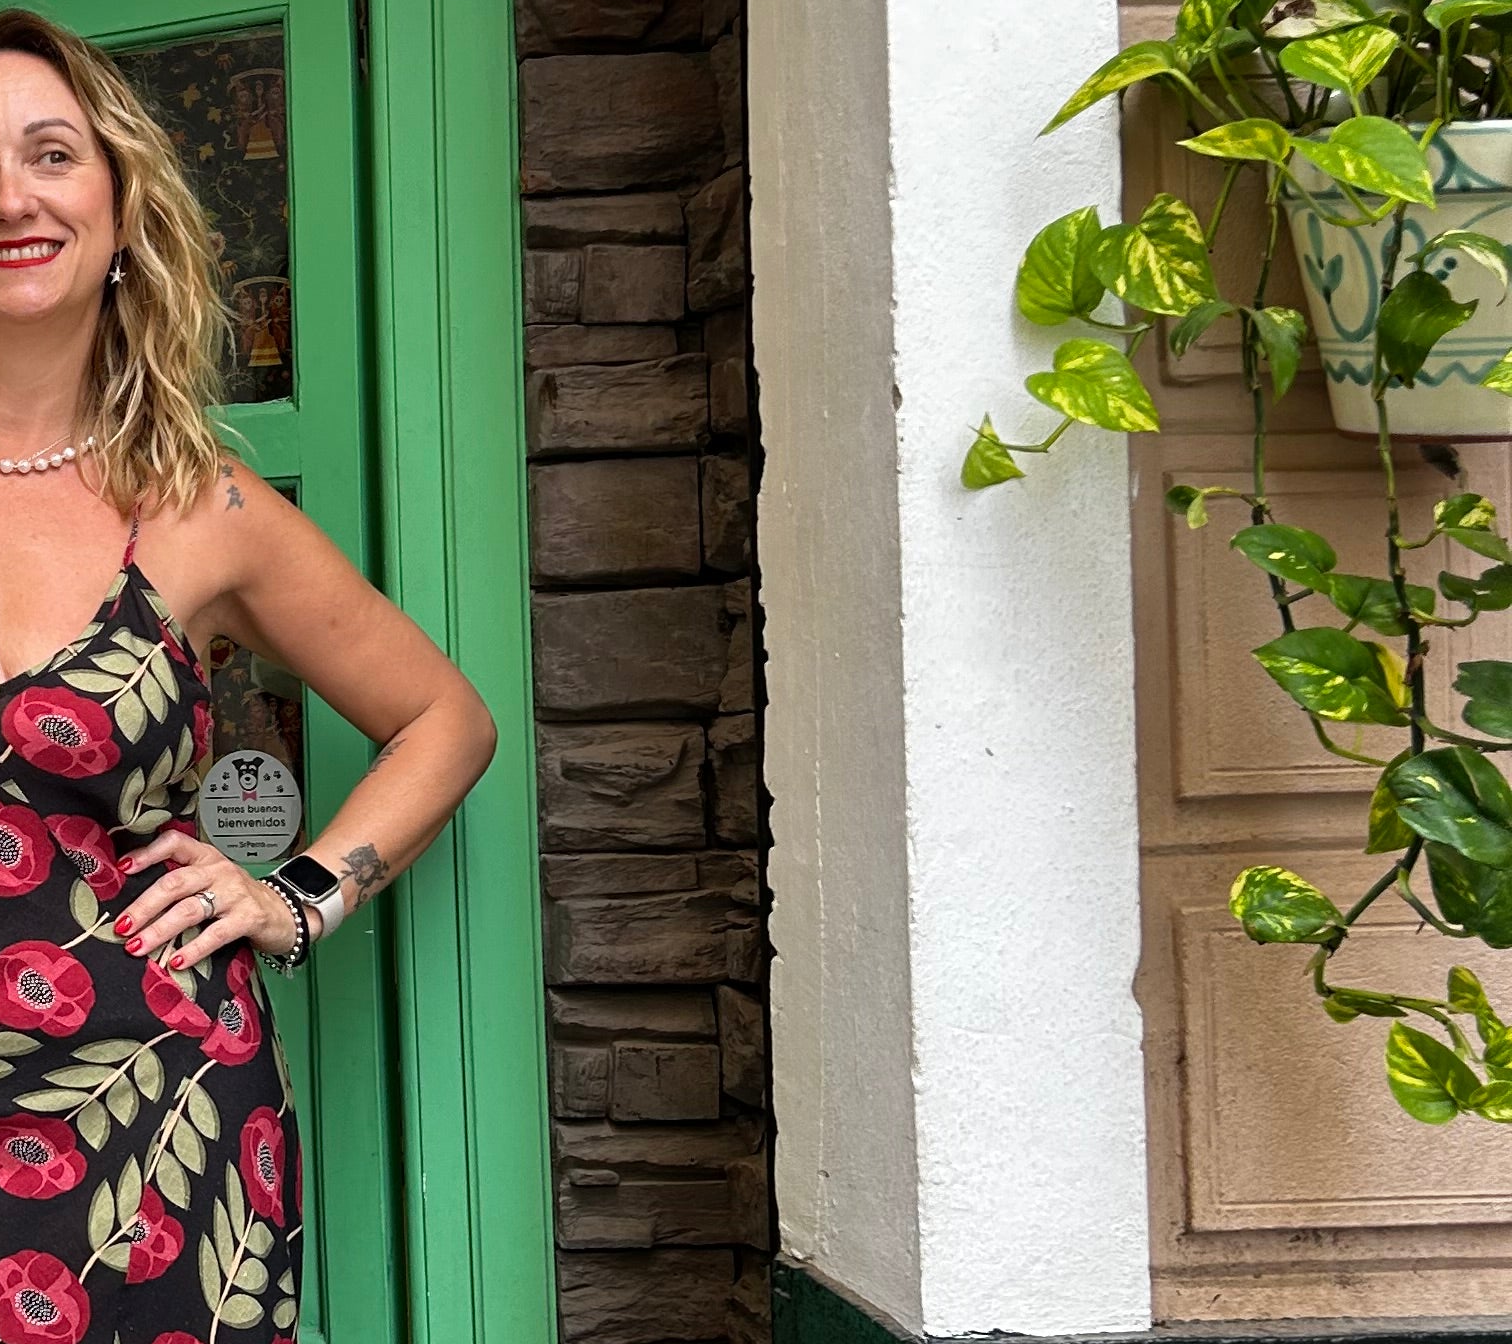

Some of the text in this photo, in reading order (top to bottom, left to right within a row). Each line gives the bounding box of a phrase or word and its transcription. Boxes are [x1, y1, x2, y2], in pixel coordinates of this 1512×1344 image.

[217, 804, 286, 814] Perros buenos,
[217, 816, 286, 828] bienvenidos
